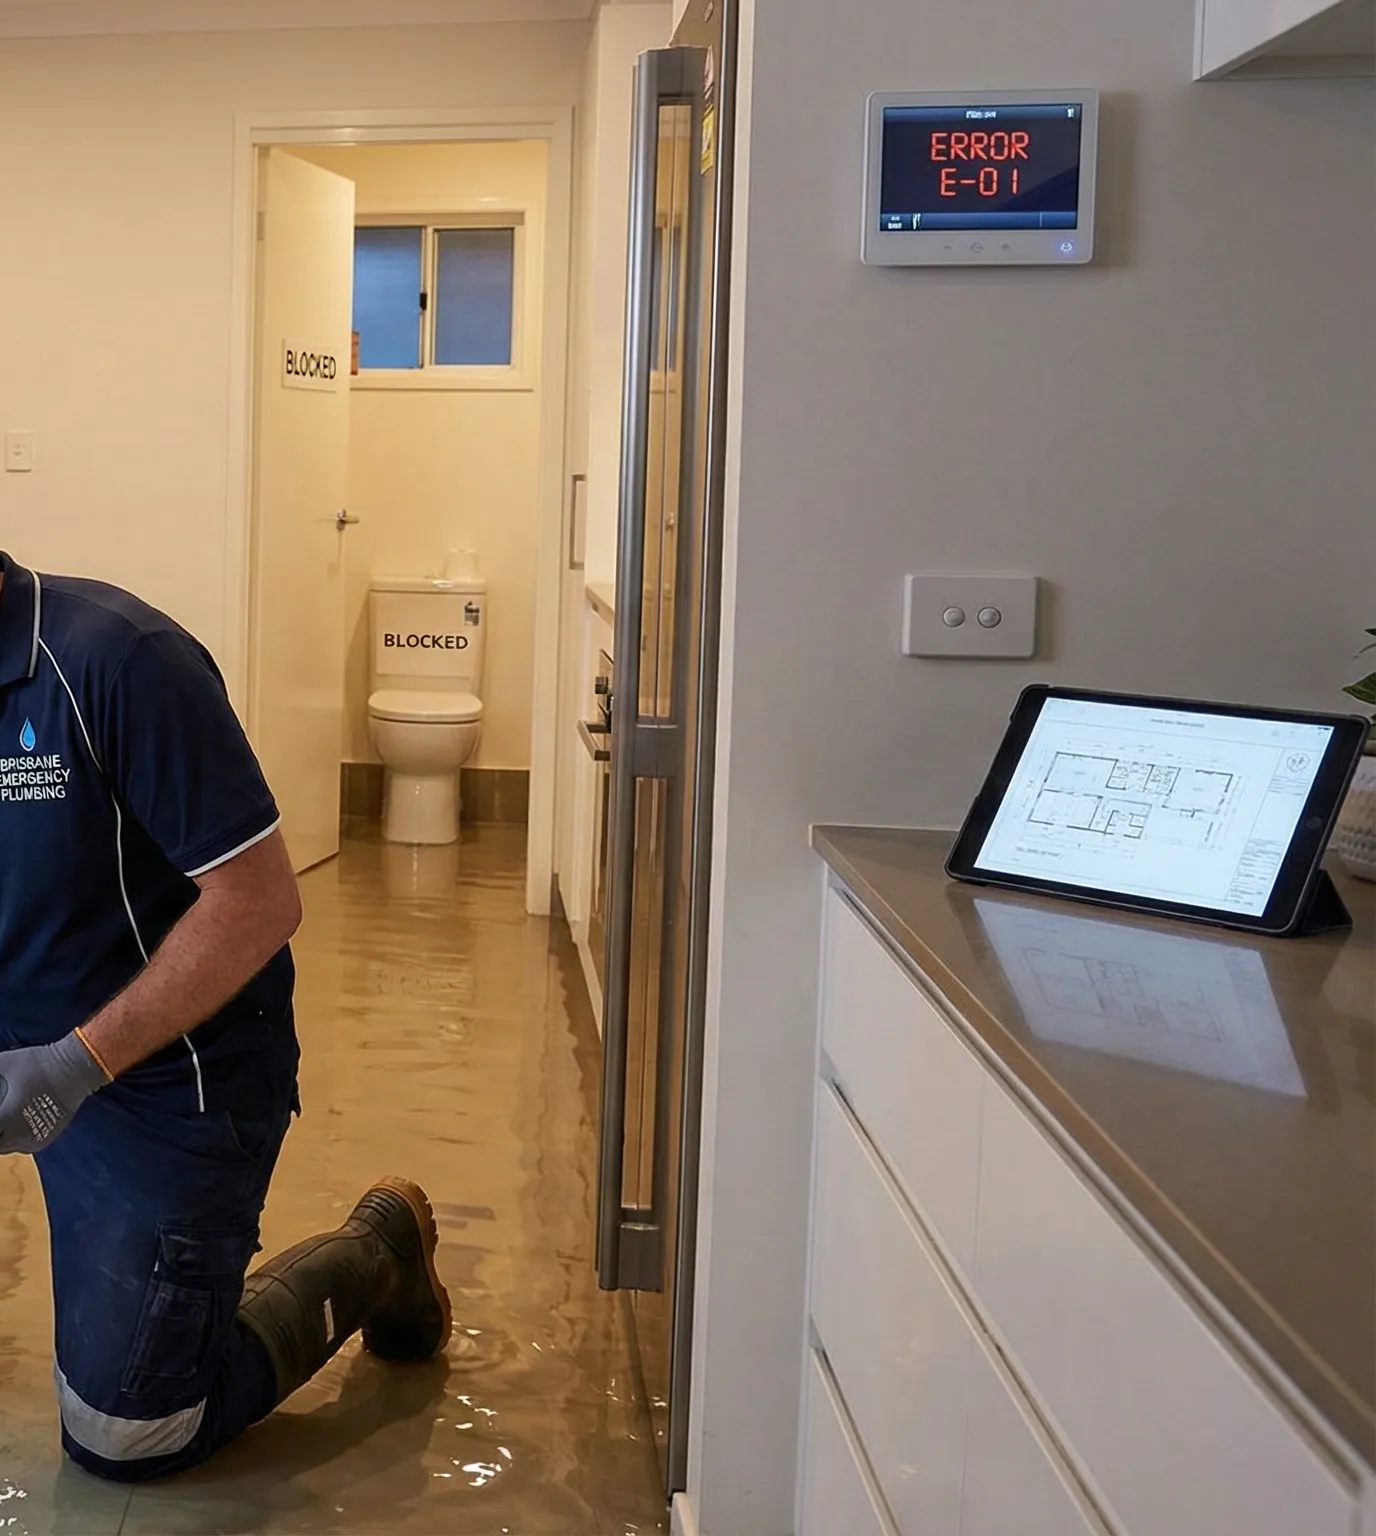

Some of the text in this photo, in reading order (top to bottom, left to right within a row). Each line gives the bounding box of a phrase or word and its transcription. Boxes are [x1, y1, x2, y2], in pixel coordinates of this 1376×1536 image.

[931, 132, 1029, 160] ERROR
[940, 168, 1019, 195] E-01
[286, 350, 336, 379] BLOCKED
[384, 633, 468, 649] BLOCKED
[0, 755, 61, 771] BRISBANE
[1, 785, 66, 801] PLUMBING
